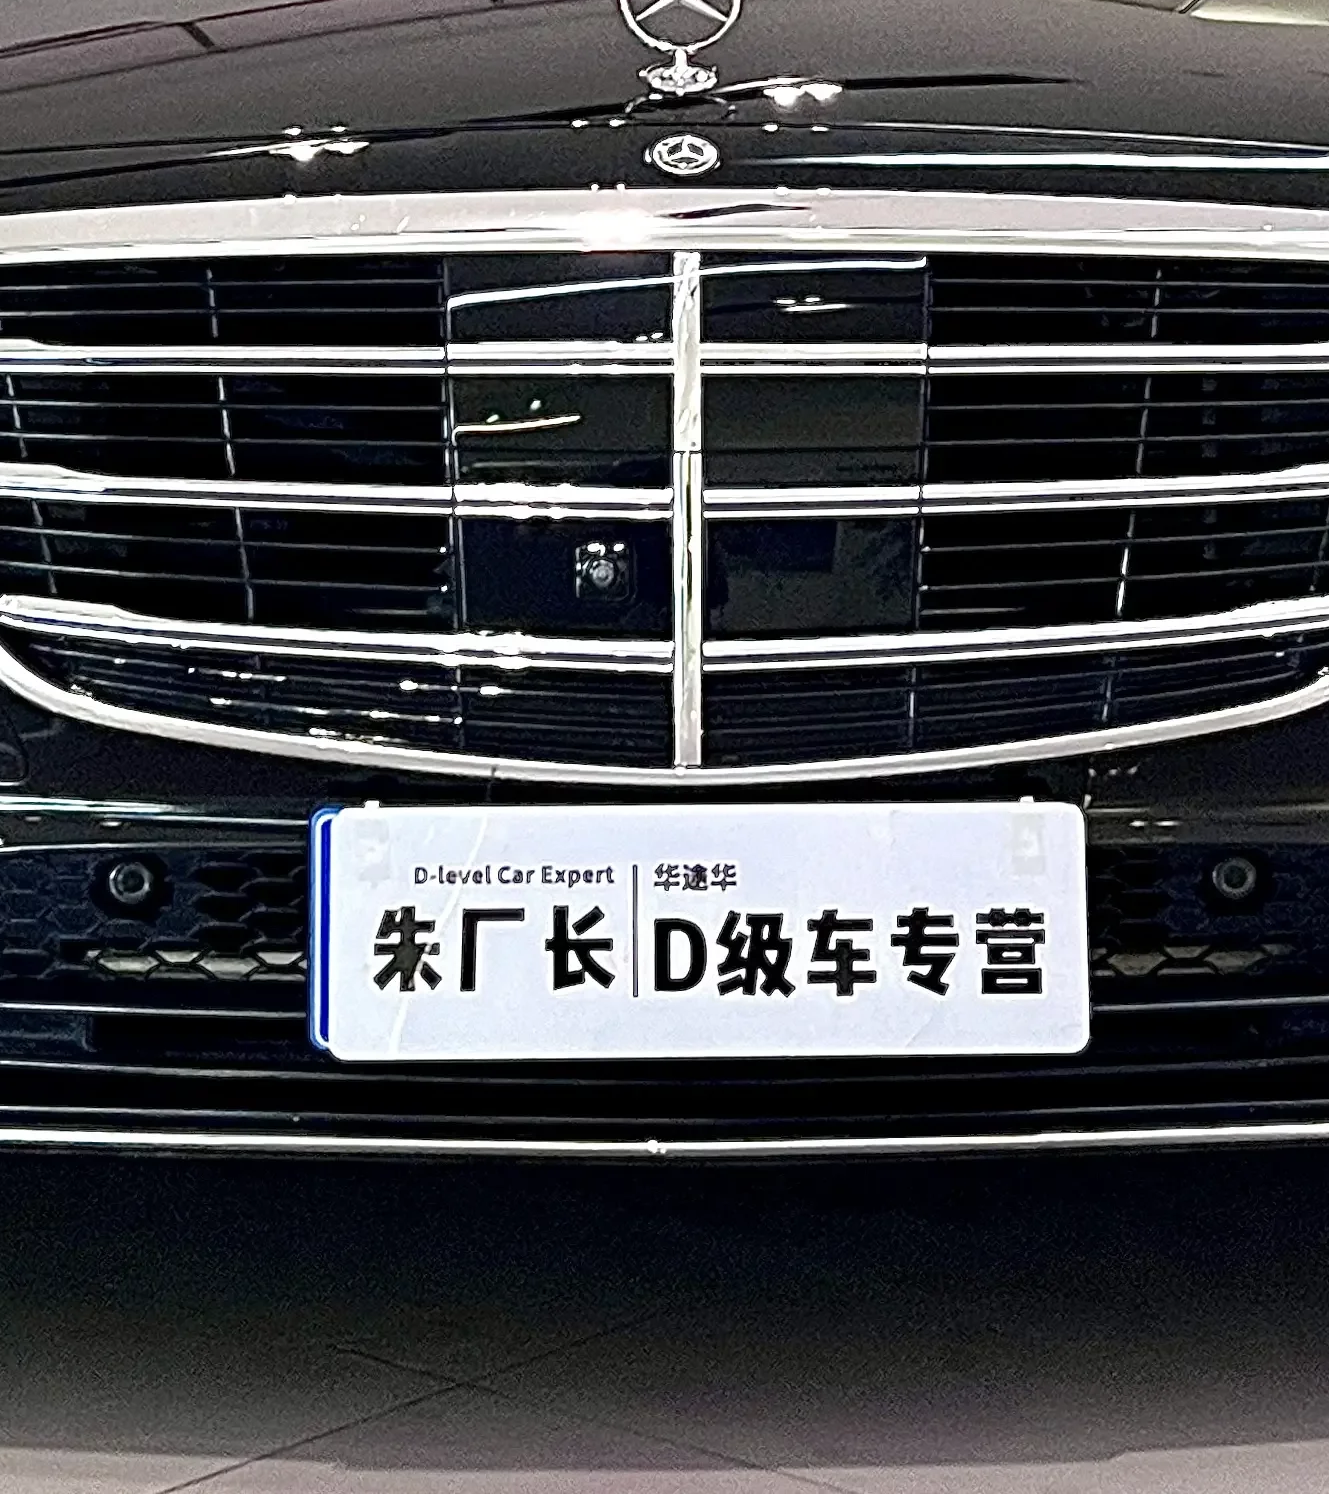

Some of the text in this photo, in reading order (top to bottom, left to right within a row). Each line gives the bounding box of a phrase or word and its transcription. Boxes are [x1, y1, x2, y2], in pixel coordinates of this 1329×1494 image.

[414, 864, 615, 889] D-level Car Expert
[653, 906, 1046, 998] D级车专营
